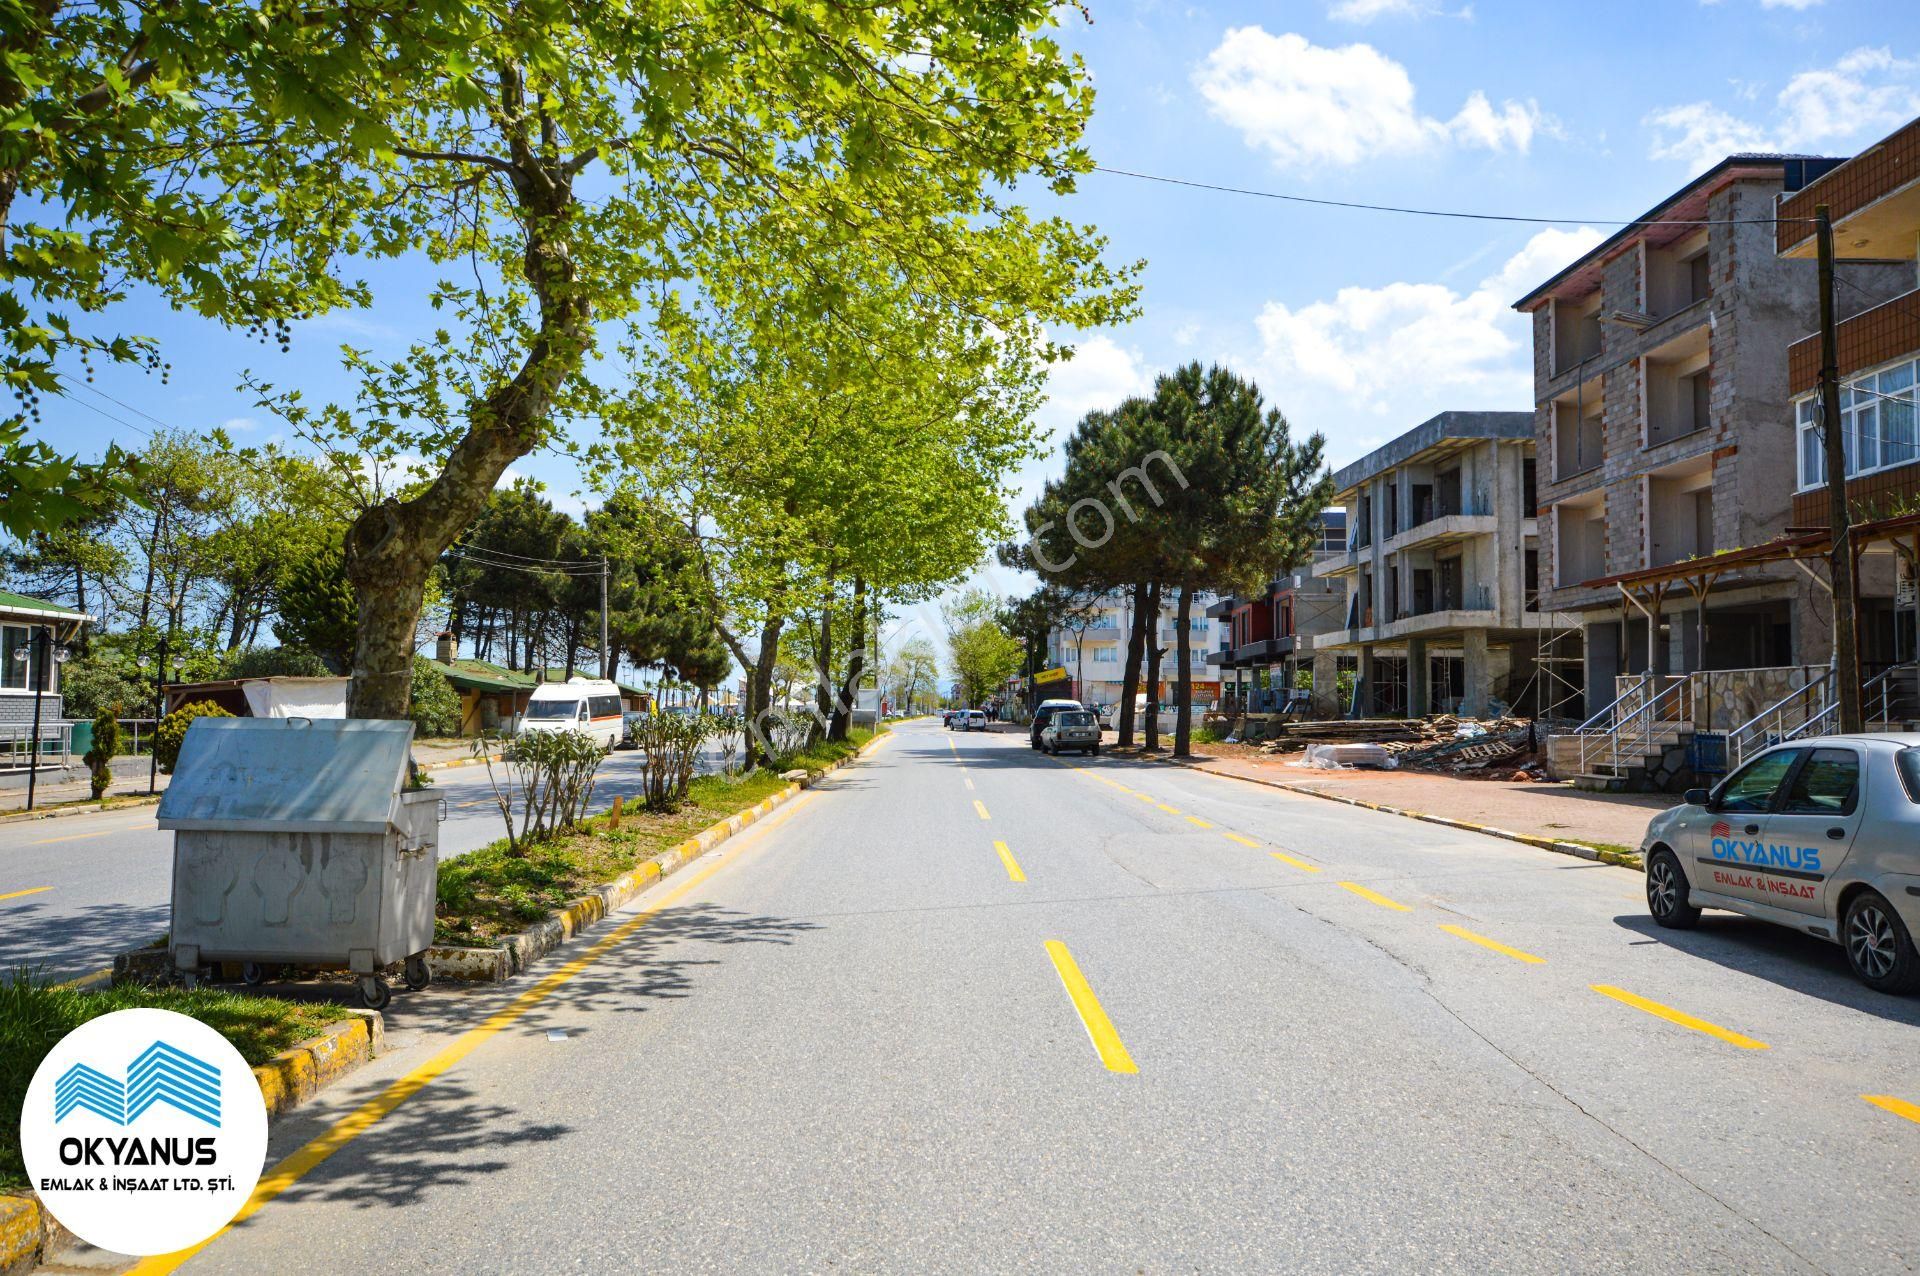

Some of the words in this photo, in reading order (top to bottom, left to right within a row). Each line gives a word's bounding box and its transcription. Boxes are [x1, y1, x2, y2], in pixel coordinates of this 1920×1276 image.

[1712, 838, 1821, 870] OKYANUS
[1714, 872, 1753, 888] EMLAK
[1757, 878, 1766, 891] &
